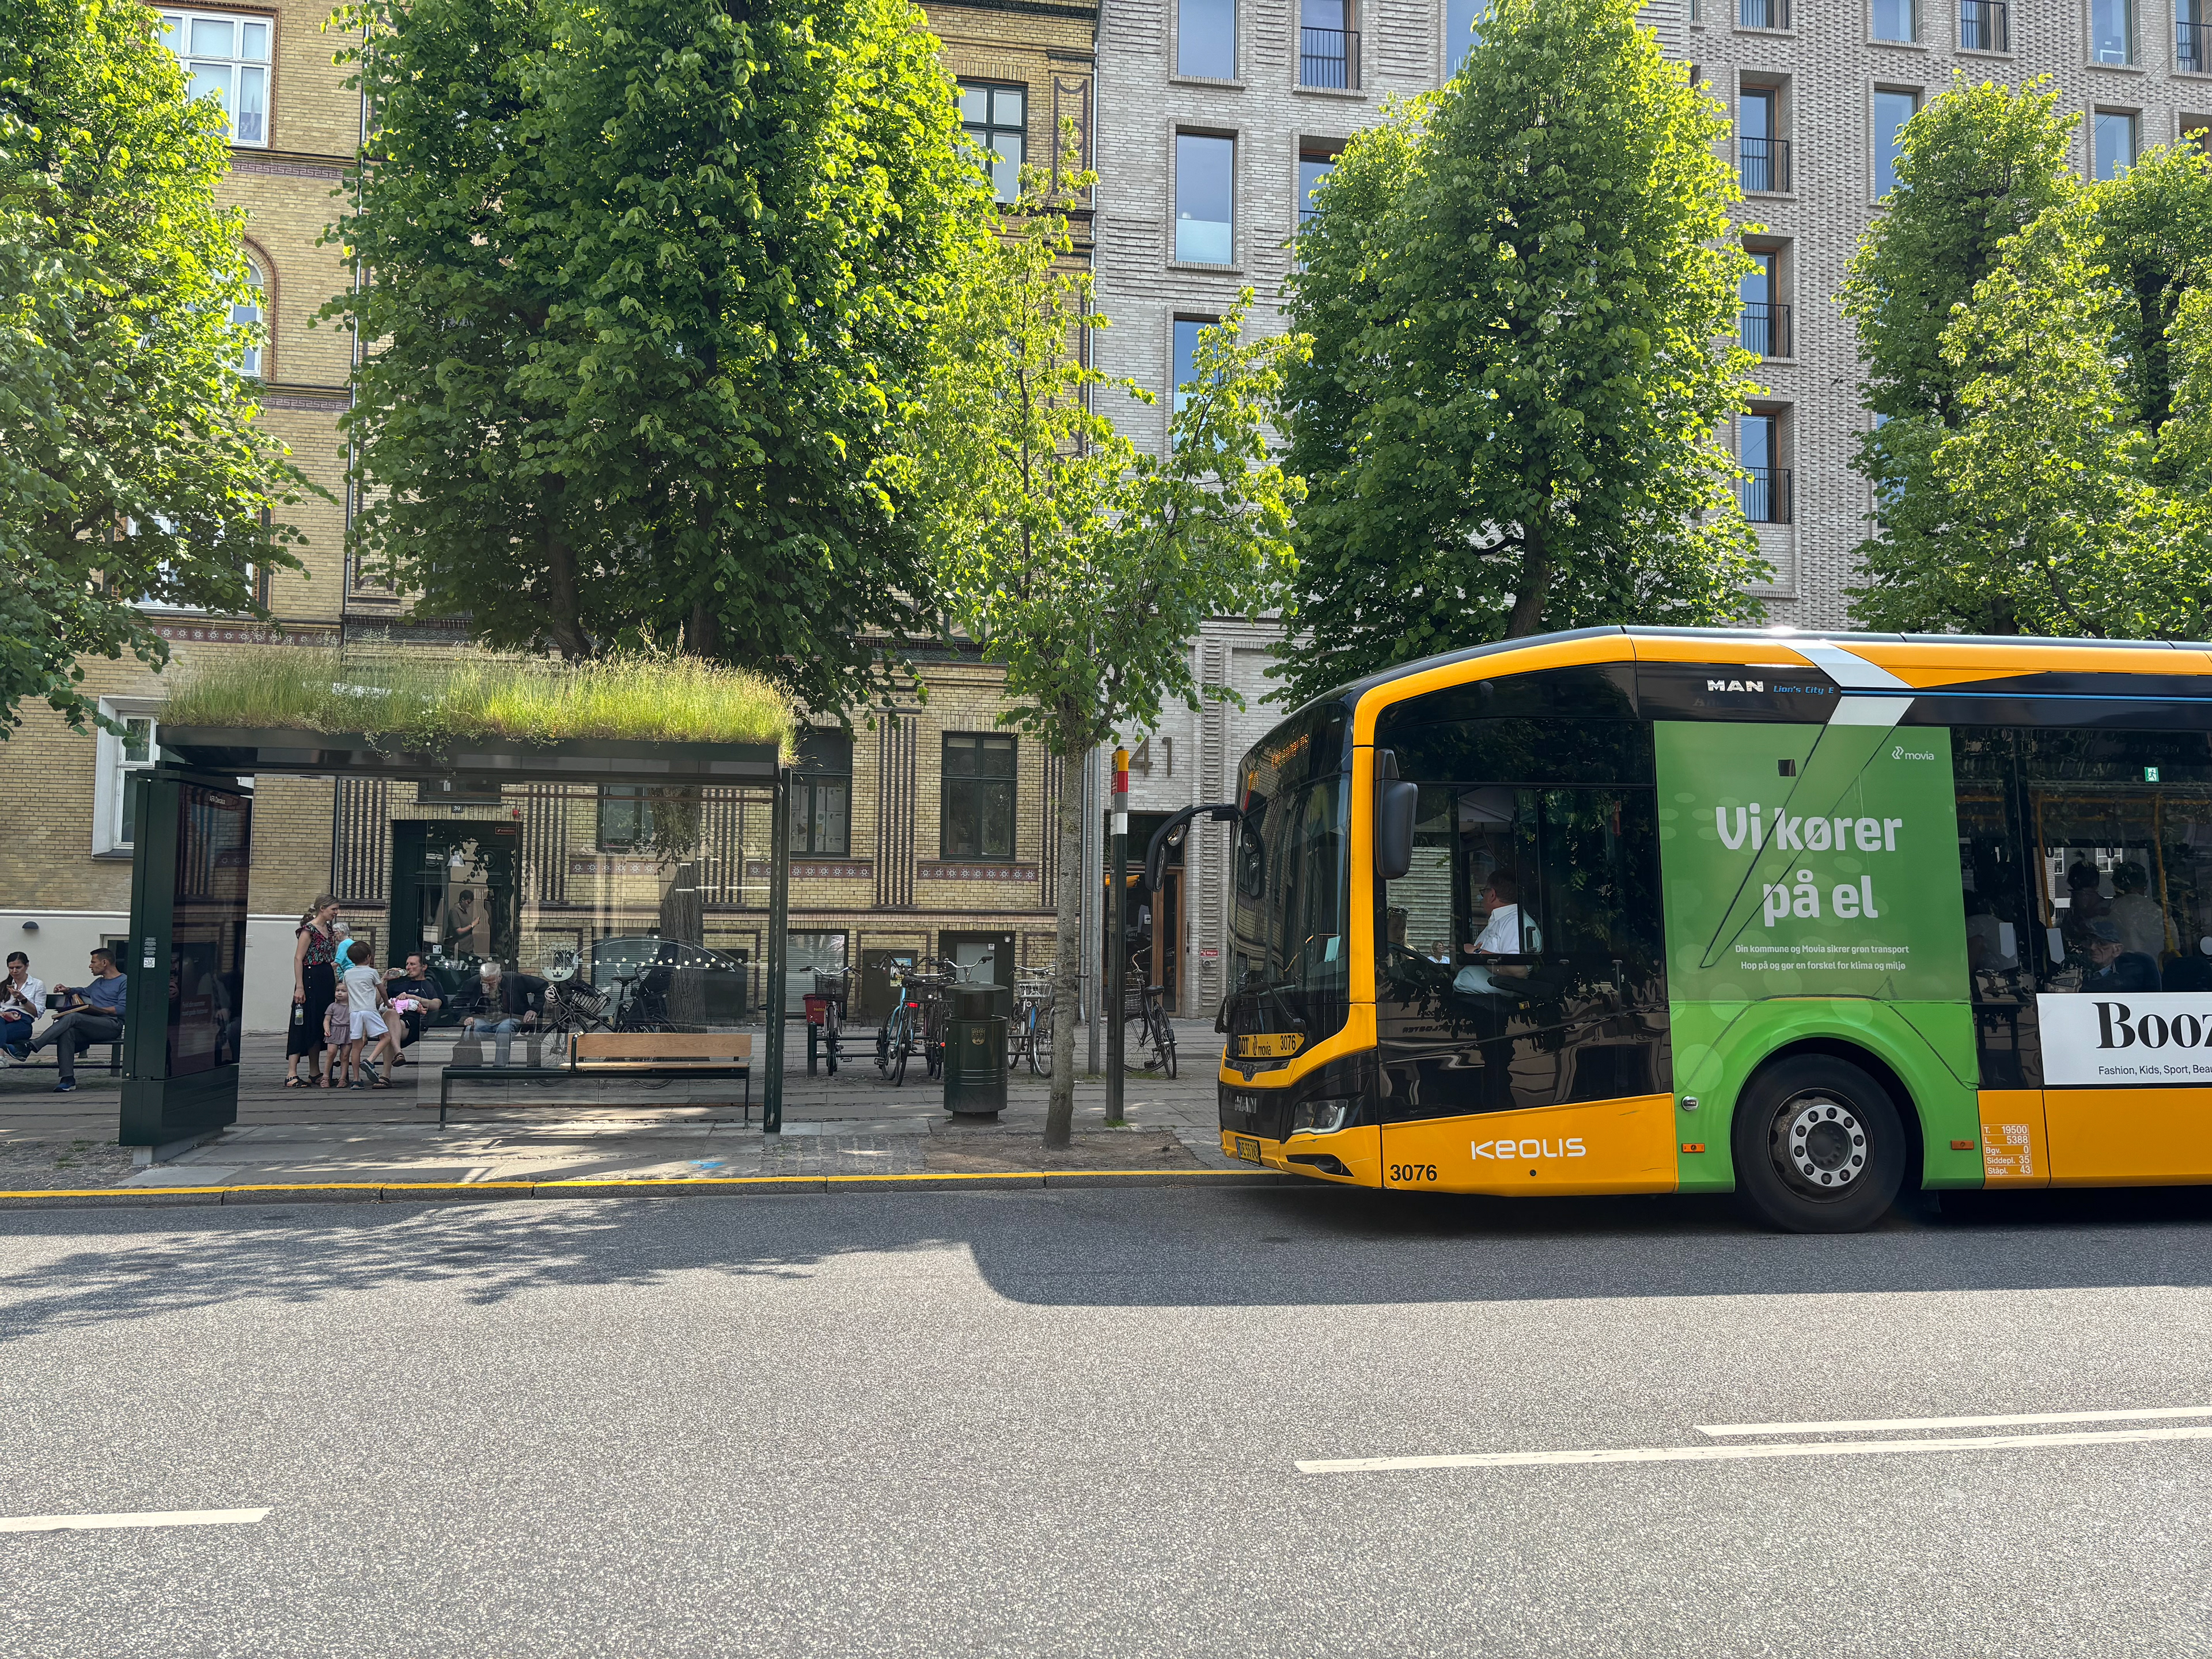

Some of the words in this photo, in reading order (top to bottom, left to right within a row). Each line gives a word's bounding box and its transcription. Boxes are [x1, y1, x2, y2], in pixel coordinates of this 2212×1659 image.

[1707, 680, 1764, 692] MAN
[1128, 736, 1172, 776] 41
[1904, 751, 1934, 761] movia
[1715, 802, 1762, 850] Vi
[1774, 808, 1902, 851] kører
[1763, 869, 1820, 927] på
[1832, 876, 1878, 918] el
[1871, 946, 1909, 955] transport
[1741, 961, 1757, 970] Hop
[1758, 961, 1768, 970] på
[1781, 963, 1794, 971] gør
[1807, 961, 1836, 969] forskel
[1838, 961, 1849, 969] for
[1851, 961, 1873, 969] klima
[1885, 961, 1906, 971] miljø
[1280, 1035, 1296, 1050] 3076
[1257, 1041, 1271, 1055] movia
[2099, 1066, 2137, 1075] Fashion,
[2139, 1066, 2161, 1075] Kids,
[2164, 1065, 2191, 1075] Sport,
[2001, 1126, 2027, 1134] 19500
[2006, 1136, 2028, 1144] 5388
[2024, 1146, 2029, 1154] 0
[2019, 1156, 2029, 1164] 35
[1389, 1164, 1437, 1181] 3076
[2020, 1165, 2031, 1173] 43
